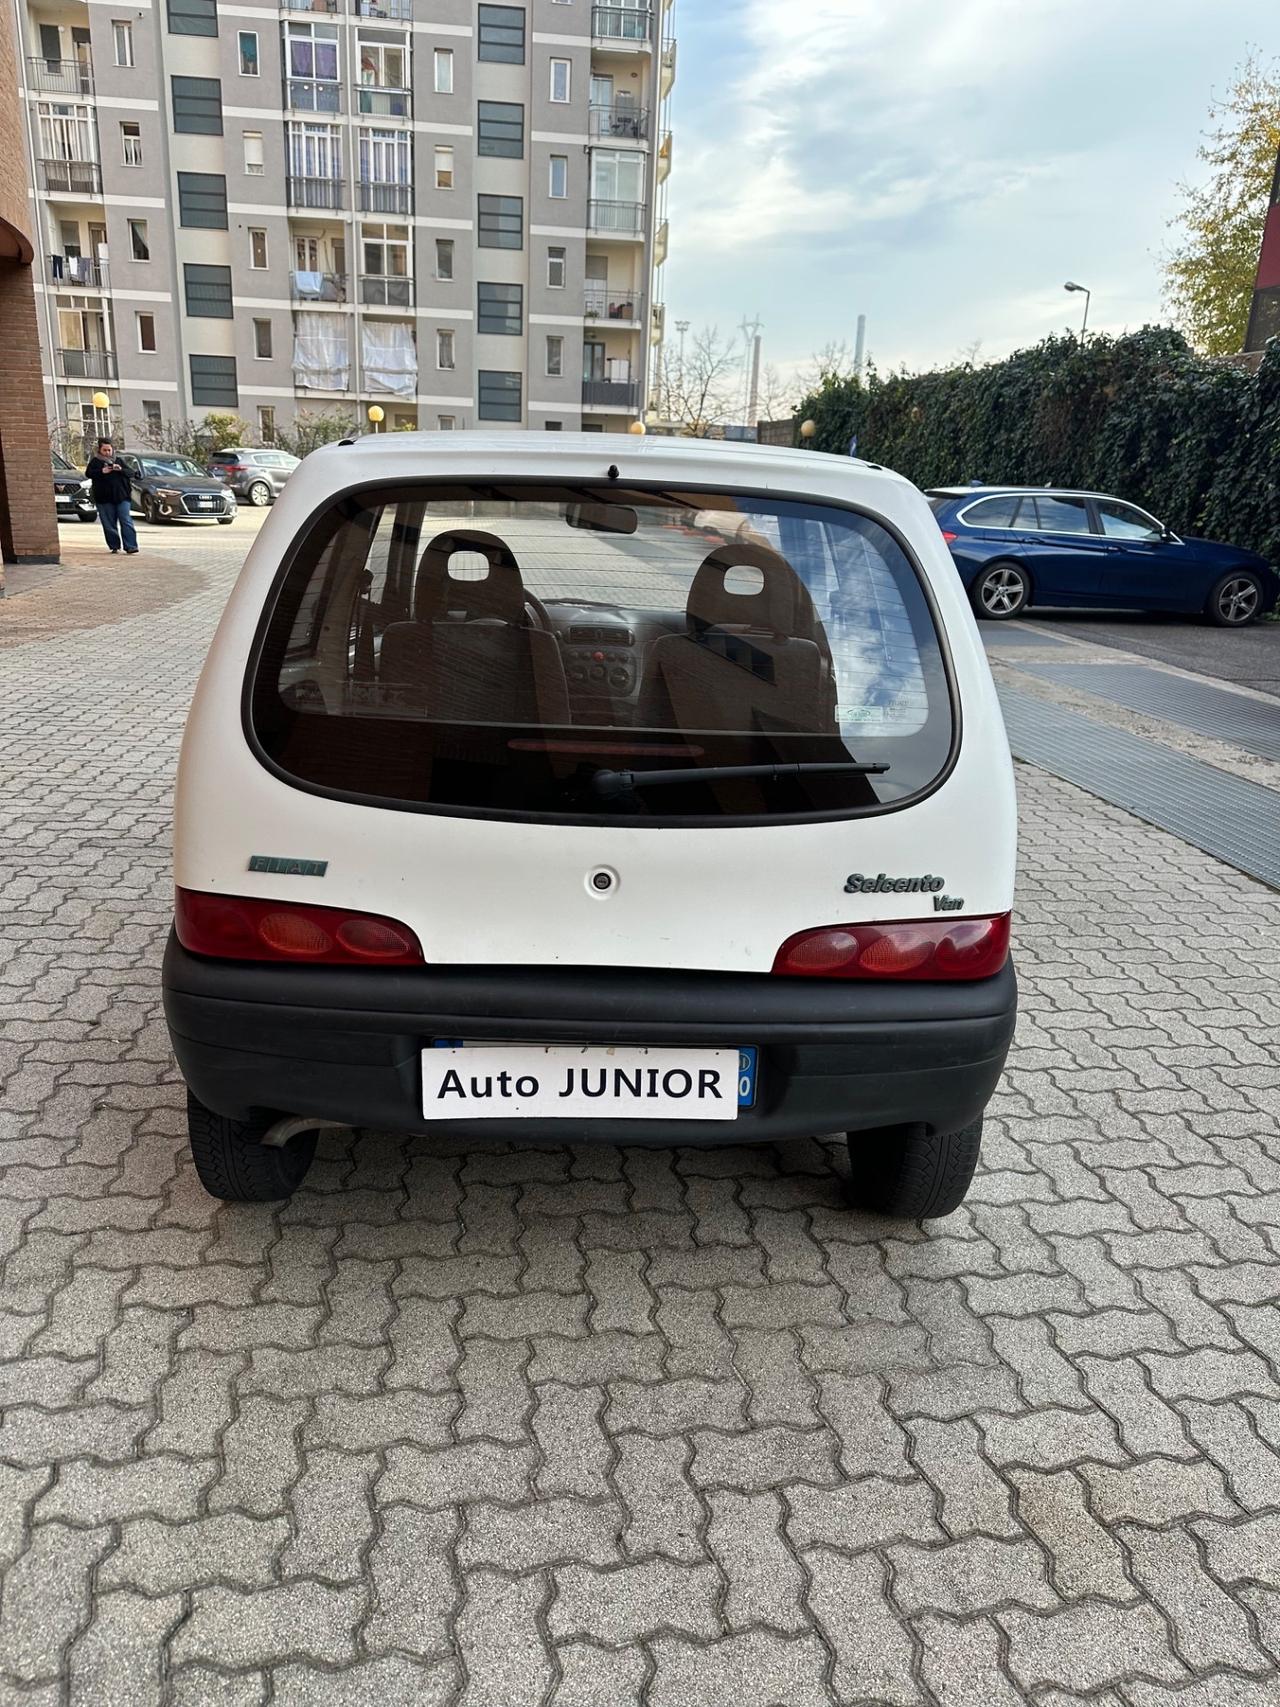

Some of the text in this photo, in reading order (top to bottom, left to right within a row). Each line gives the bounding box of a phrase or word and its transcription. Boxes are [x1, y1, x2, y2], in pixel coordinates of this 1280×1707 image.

[252, 857, 325, 875] FIAT
[844, 873, 945, 893] Seicento
[933, 895, 964, 911] Van
[437, 1068, 722, 1099] Auto JUNIOR
